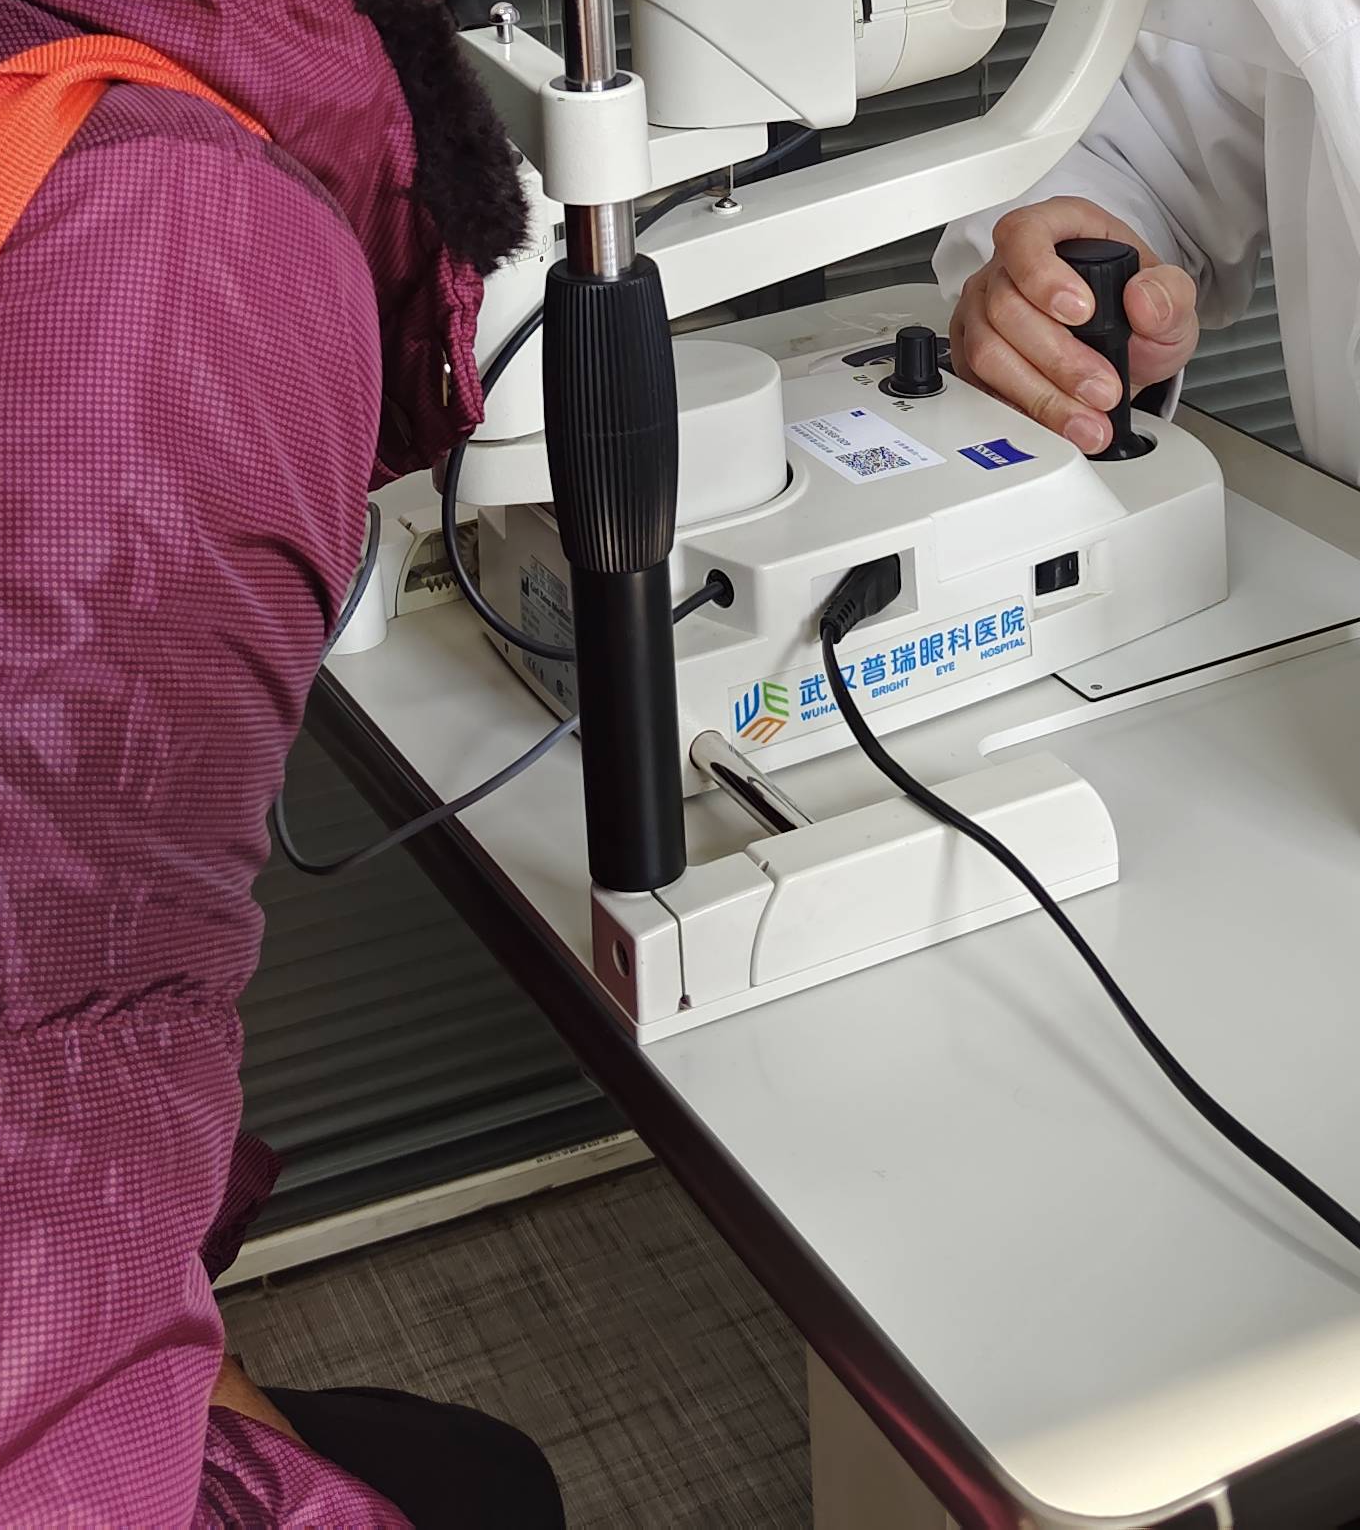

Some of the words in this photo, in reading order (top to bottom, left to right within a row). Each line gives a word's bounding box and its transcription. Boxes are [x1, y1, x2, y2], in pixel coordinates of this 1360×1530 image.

[800, 702, 841, 722] WUHA
[871, 676, 911, 699] BRIGHT
[935, 660, 956, 677] EYE
[979, 636, 1026, 661] HOSPITAL
